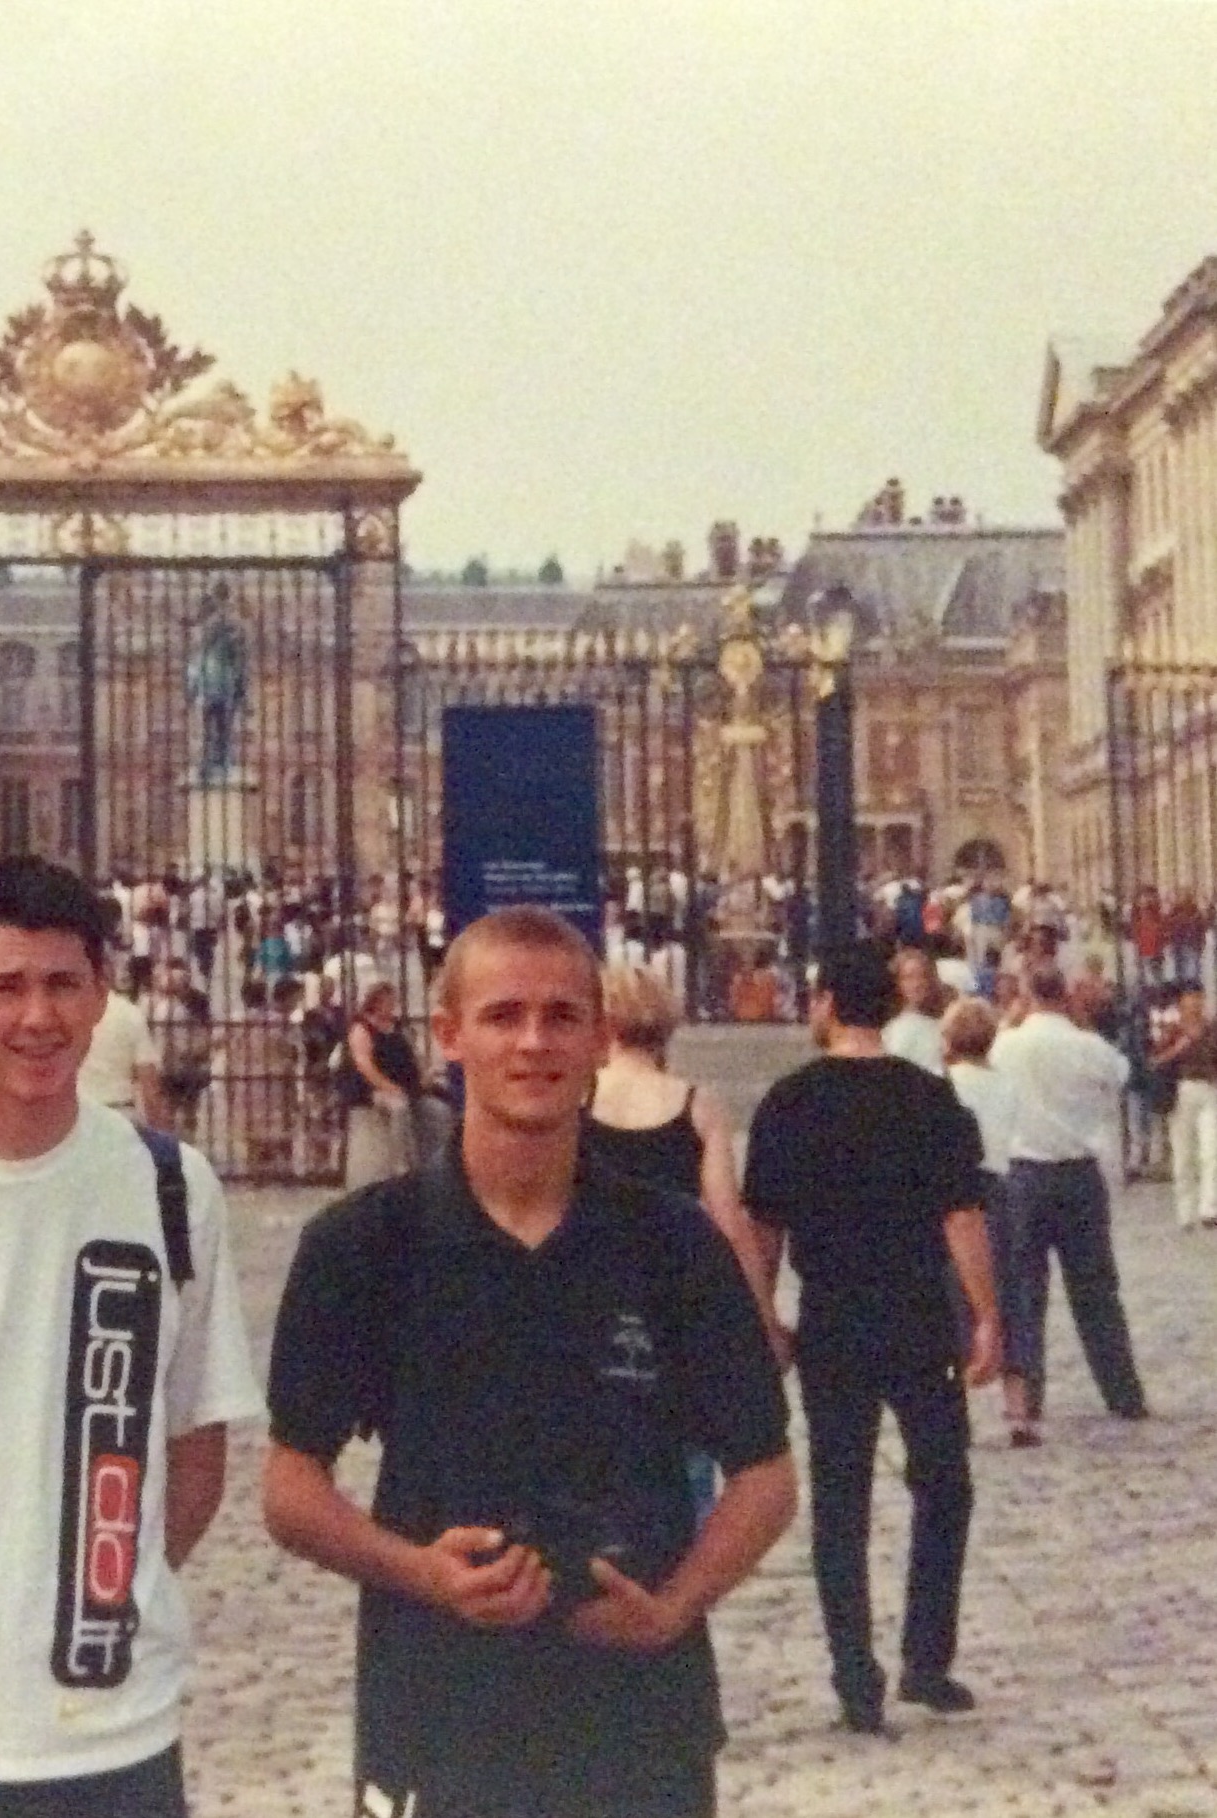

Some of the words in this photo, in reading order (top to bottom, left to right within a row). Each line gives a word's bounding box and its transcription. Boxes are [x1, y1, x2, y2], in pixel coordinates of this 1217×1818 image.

[83, 1257, 158, 1448] just
[90, 1465, 137, 1598] do
[67, 1619, 135, 1676] it
